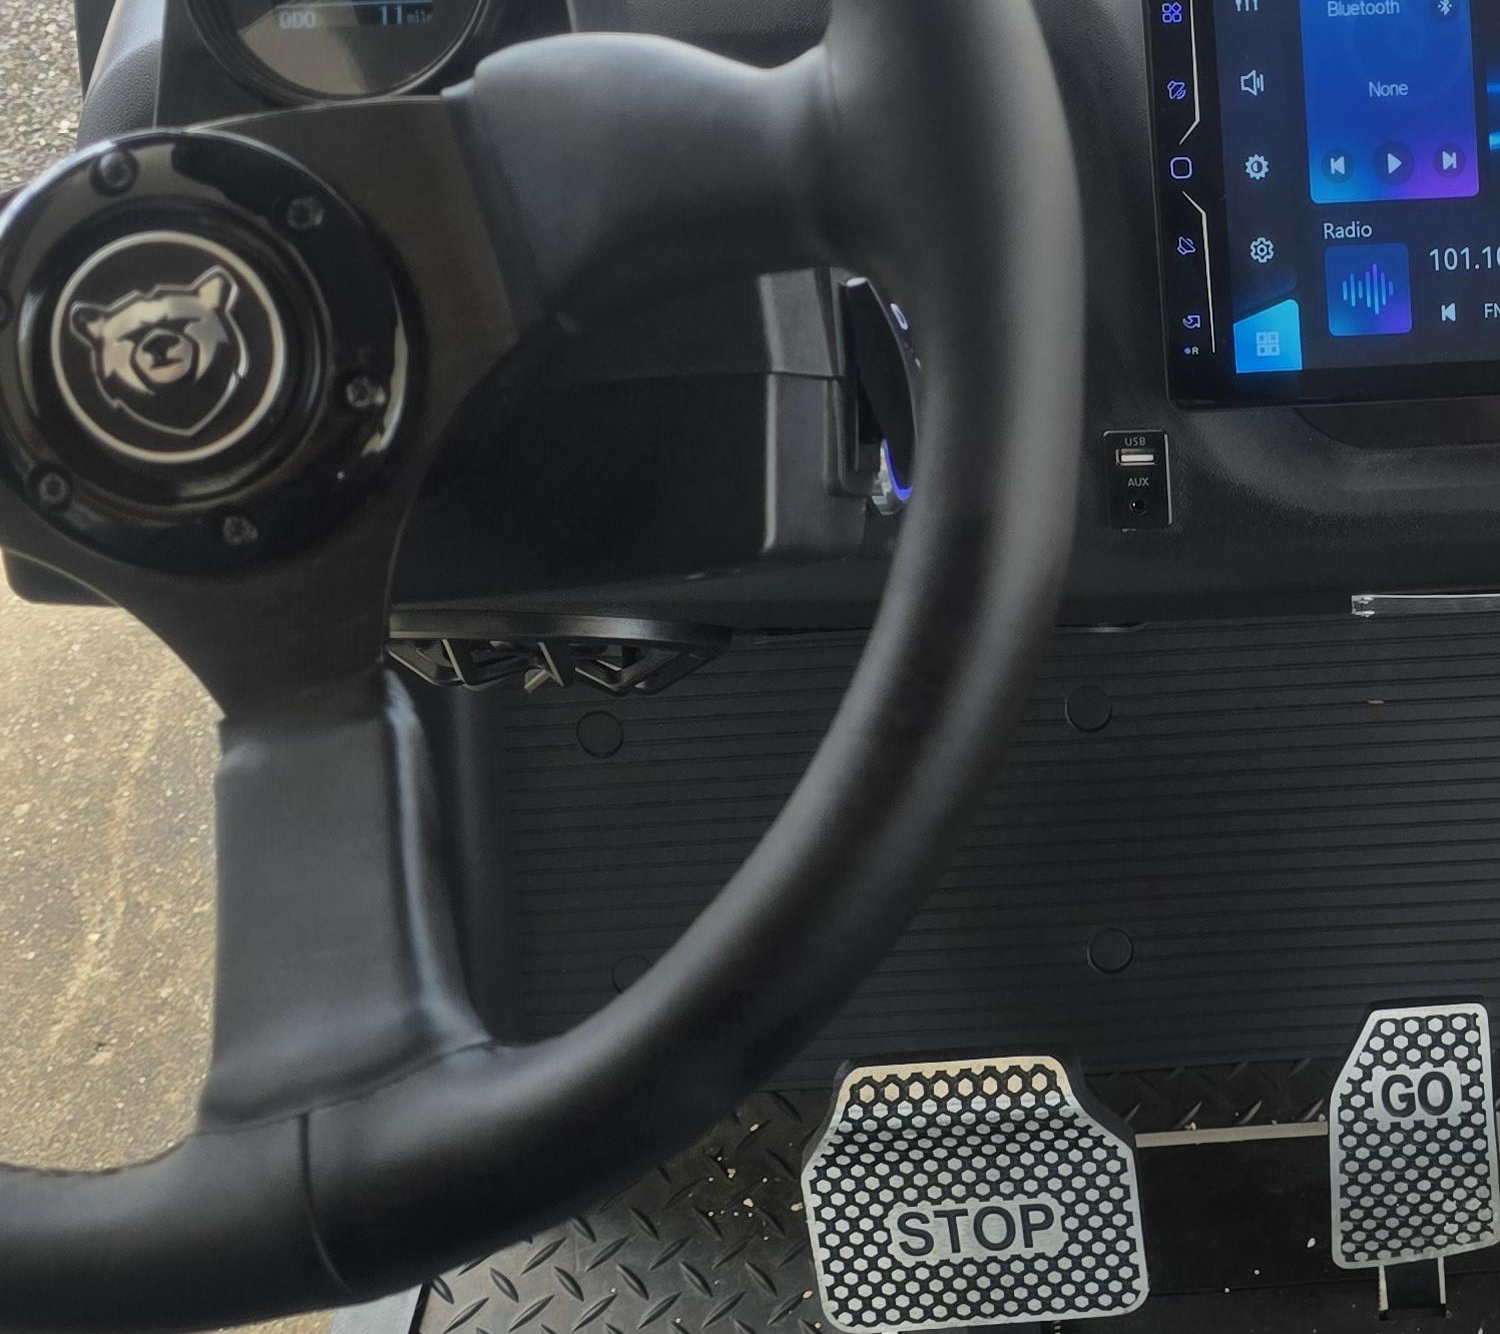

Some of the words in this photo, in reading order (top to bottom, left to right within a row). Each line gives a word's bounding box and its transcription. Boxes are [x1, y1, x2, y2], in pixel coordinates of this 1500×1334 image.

[1327, 0, 1400, 17] Bluetooth
[279, 10, 317, 29] ODO
[1368, 81, 1409, 98] None
[1323, 221, 1373, 239] Radio
[1124, 436, 1146, 447] USB
[1127, 477, 1150, 487] AUX
[1381, 1071, 1454, 1118] GO
[897, 1203, 1055, 1257] STOP
